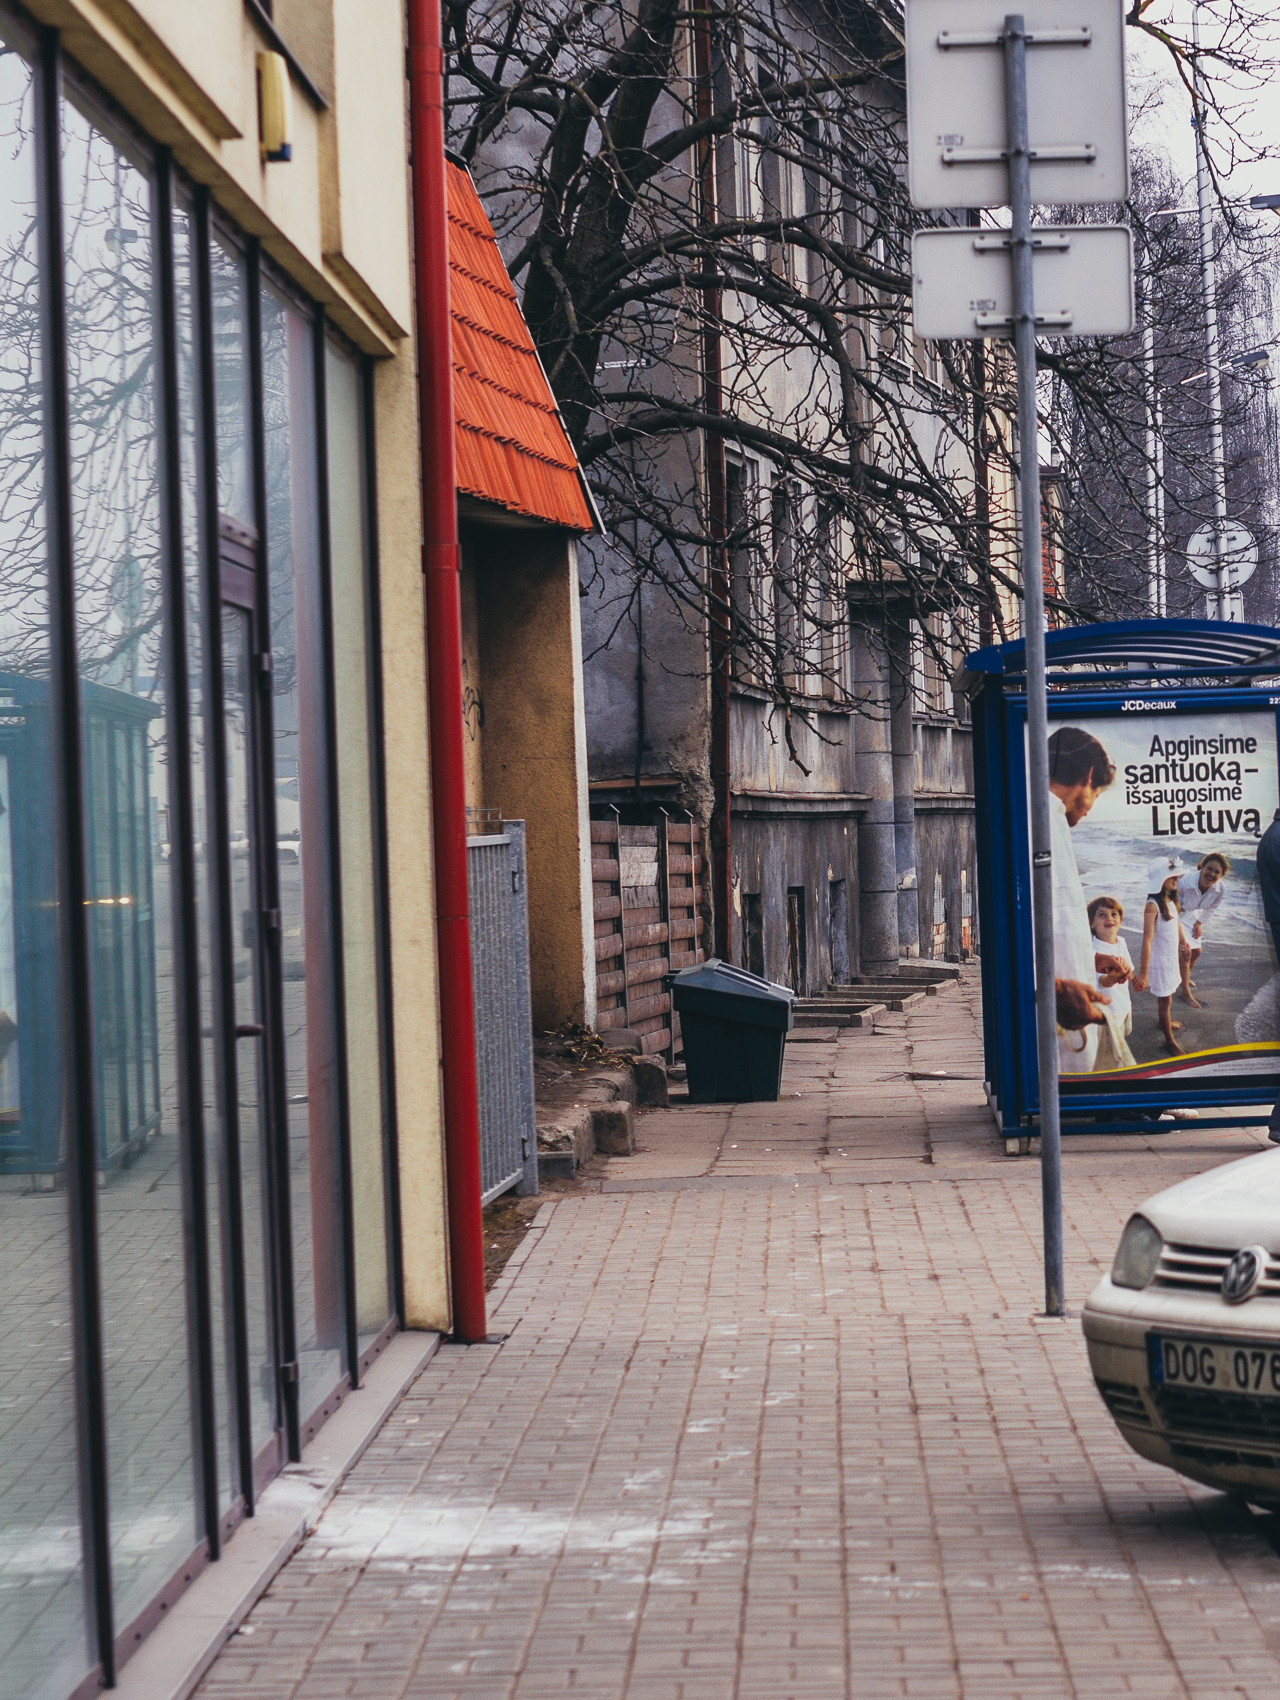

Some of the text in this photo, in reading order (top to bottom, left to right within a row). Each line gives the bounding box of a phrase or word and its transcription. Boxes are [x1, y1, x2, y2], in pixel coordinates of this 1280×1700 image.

[1121, 700, 1177, 711] JCDecaux
[1149, 734, 1258, 762] Apginsime
[1126, 783, 1243, 808] išsaugosime
[1152, 805, 1262, 838] Lietuvą
[1163, 1342, 1216, 1385] DOG
